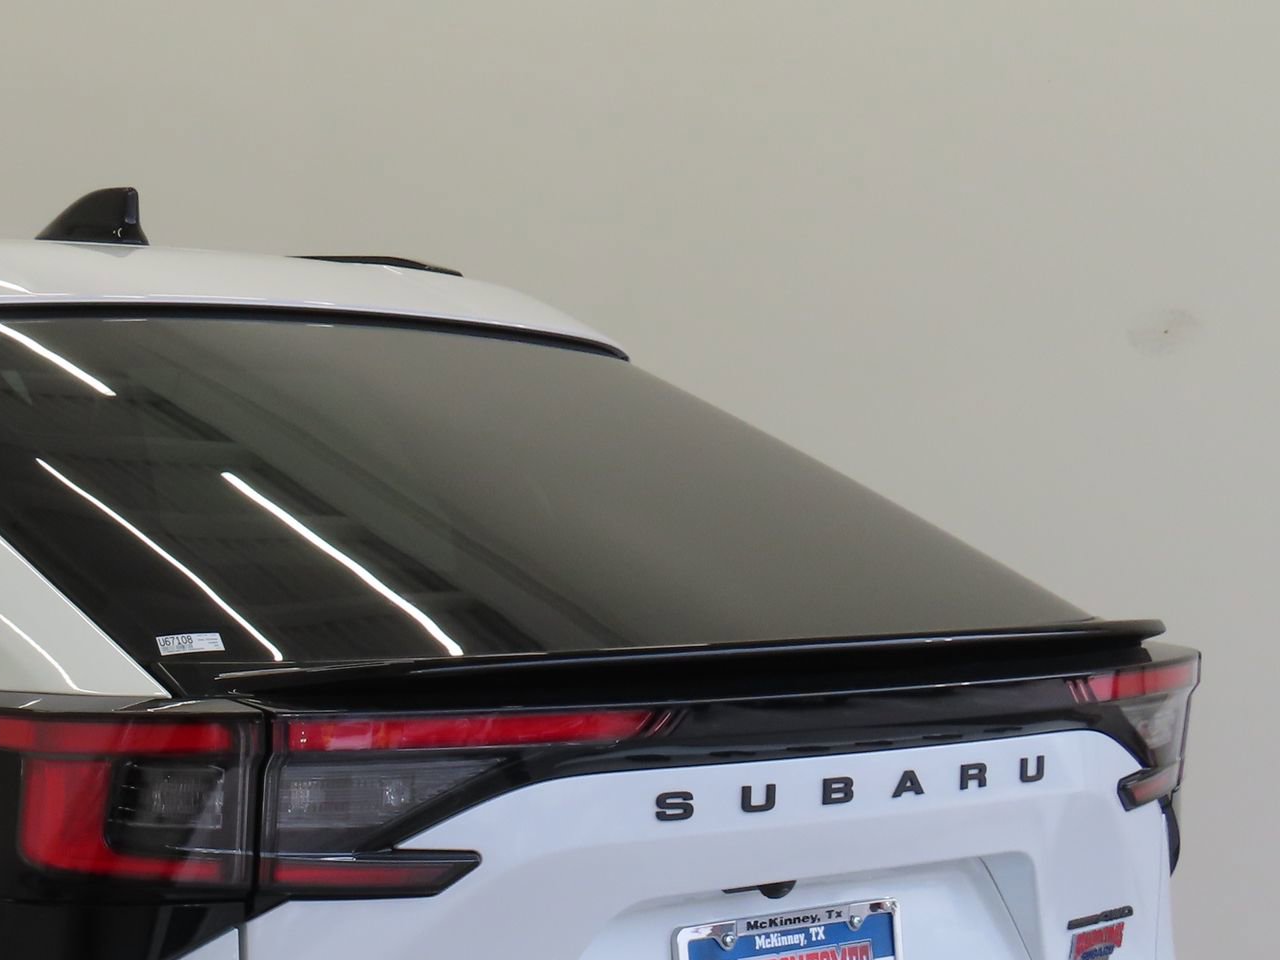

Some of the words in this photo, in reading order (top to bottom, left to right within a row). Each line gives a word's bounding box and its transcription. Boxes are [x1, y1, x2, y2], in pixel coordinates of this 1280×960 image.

[158, 635, 194, 647] U67108
[655, 755, 1045, 821] SUBARU
[746, 914, 820, 931] McKinney,
[755, 932, 806, 950] McKinney,
[809, 926, 825, 941] TX
